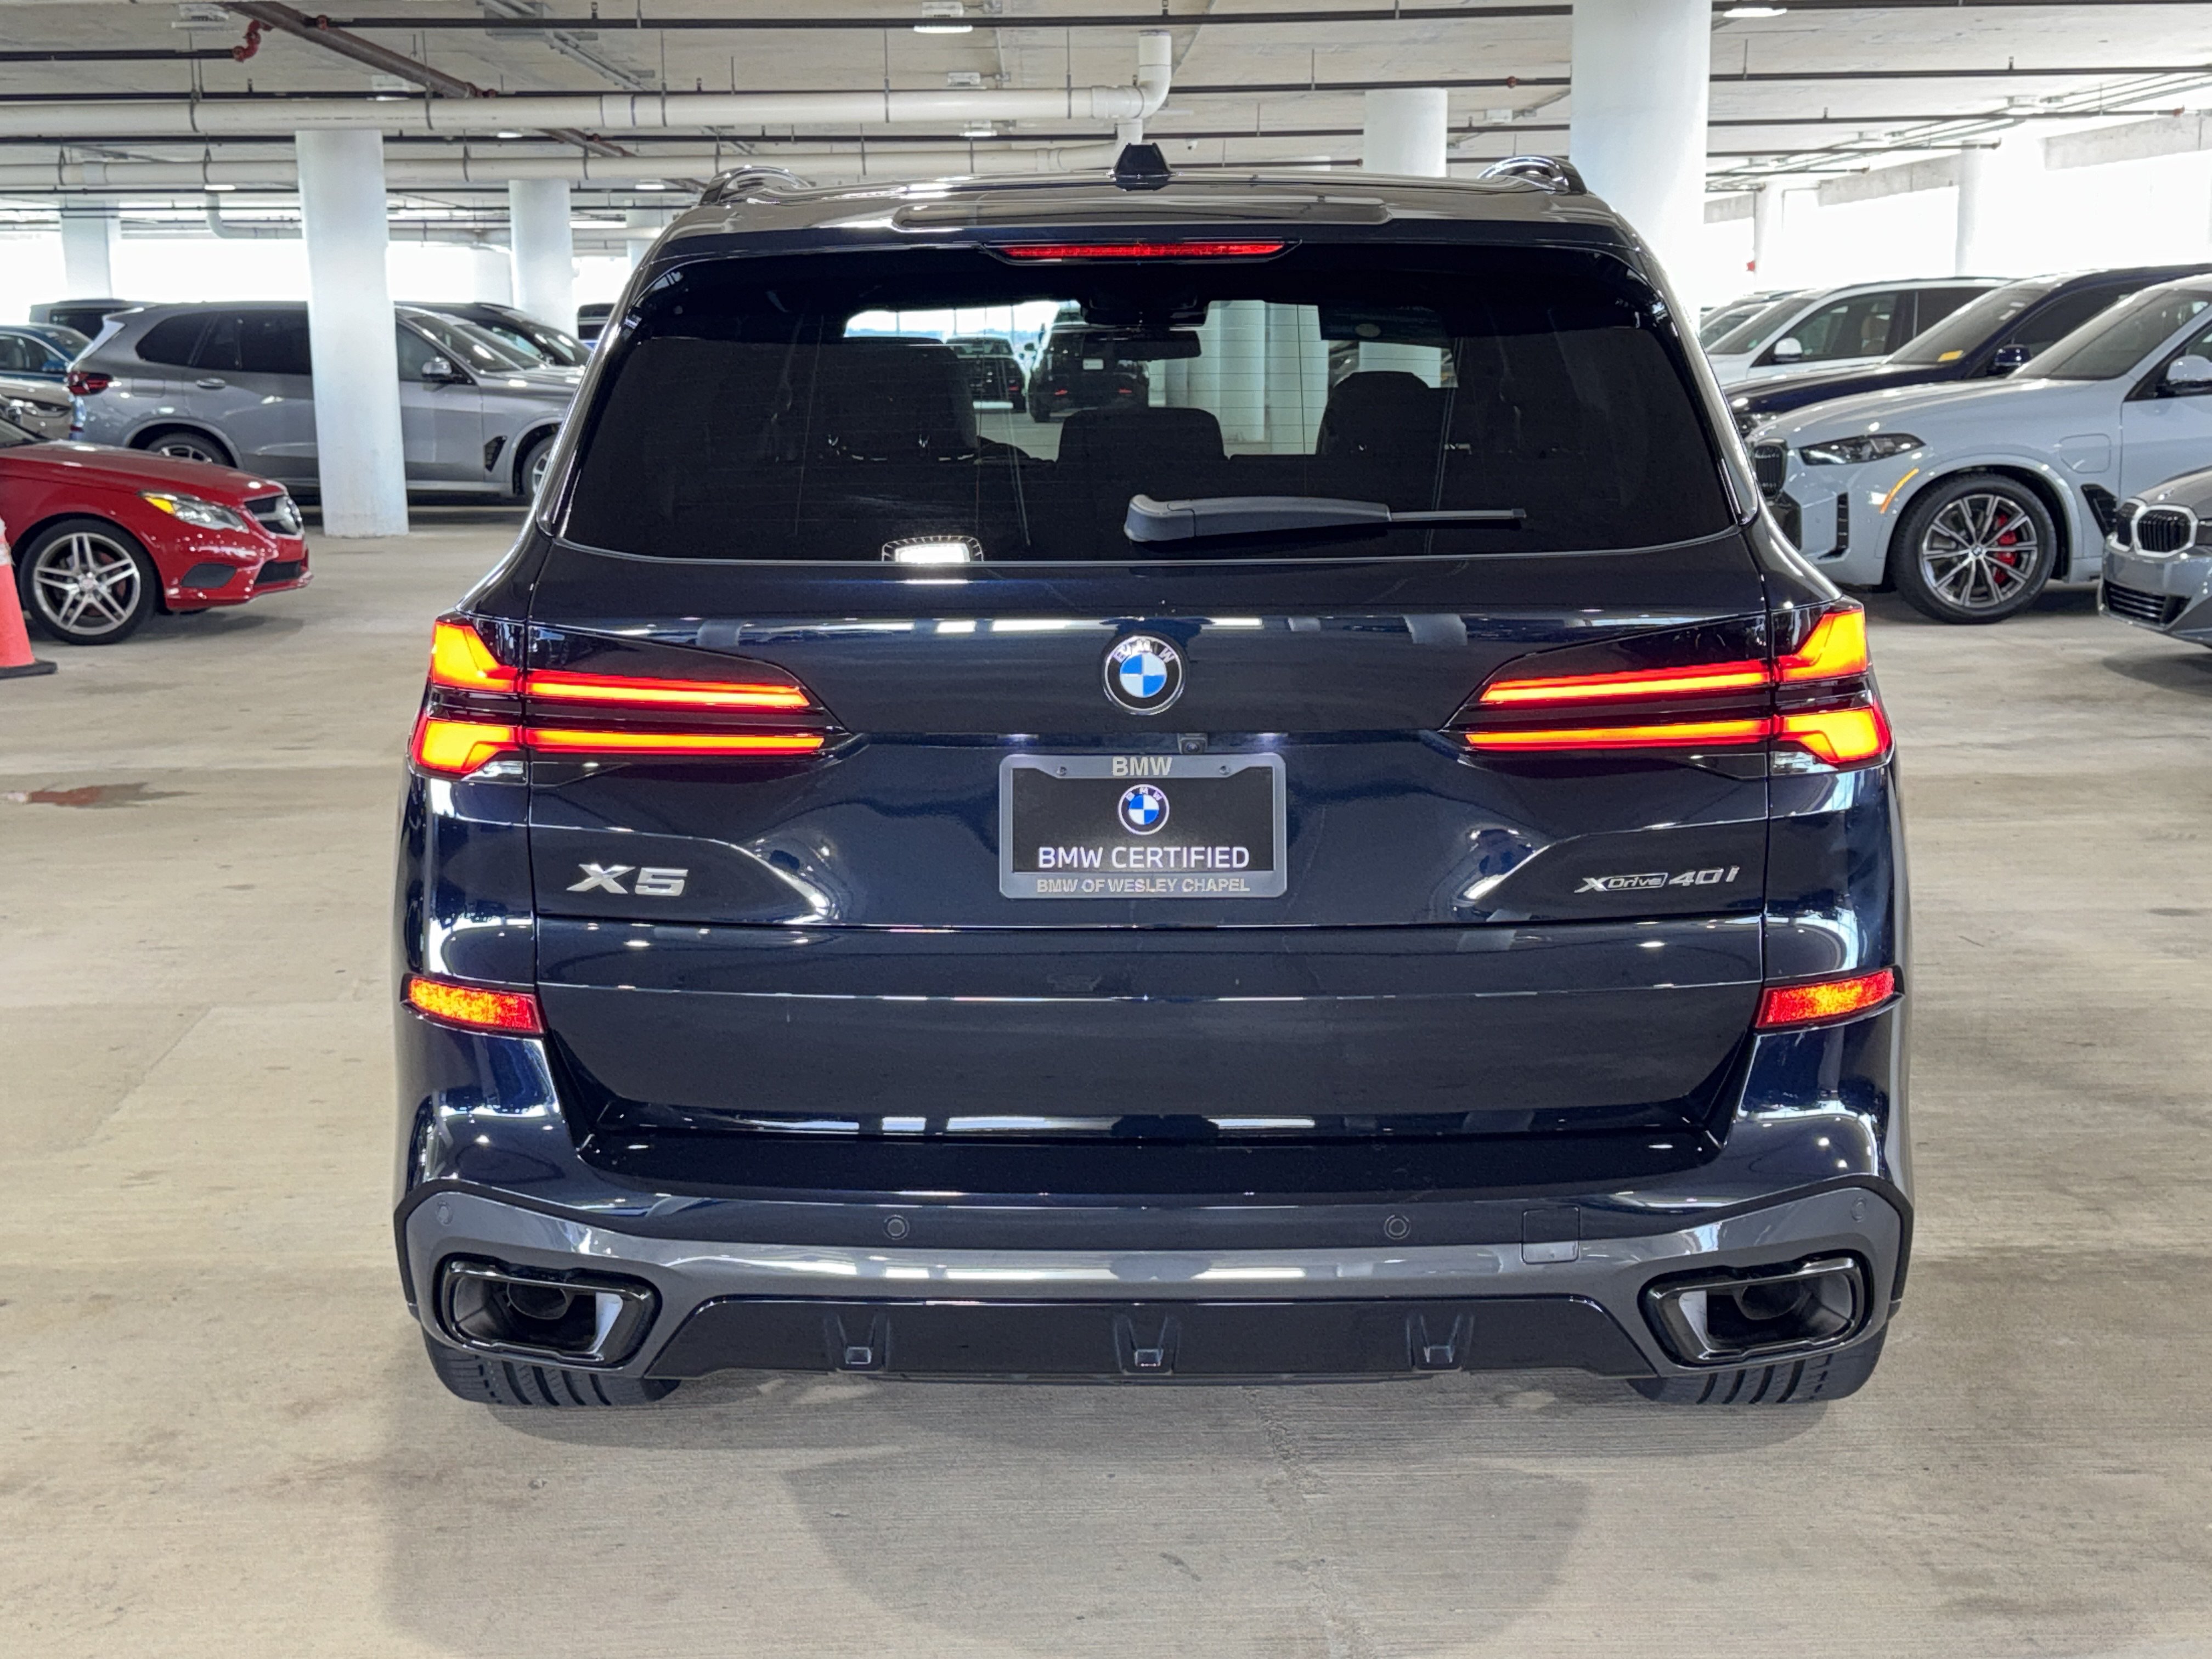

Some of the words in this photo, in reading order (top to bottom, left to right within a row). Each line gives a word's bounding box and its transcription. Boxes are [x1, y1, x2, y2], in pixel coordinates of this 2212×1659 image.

[1113, 757, 1172, 776] BMW
[1125, 787, 1163, 801] BMW
[1038, 847, 1103, 868] BMW
[1111, 847, 1250, 868] CERTIFIED
[566, 863, 689, 896] X5
[1037, 878, 1078, 893] BMW
[1081, 879, 1104, 893] OF
[1108, 878, 1177, 892] WESLEY
[1182, 878, 1250, 892] CHAPEL
